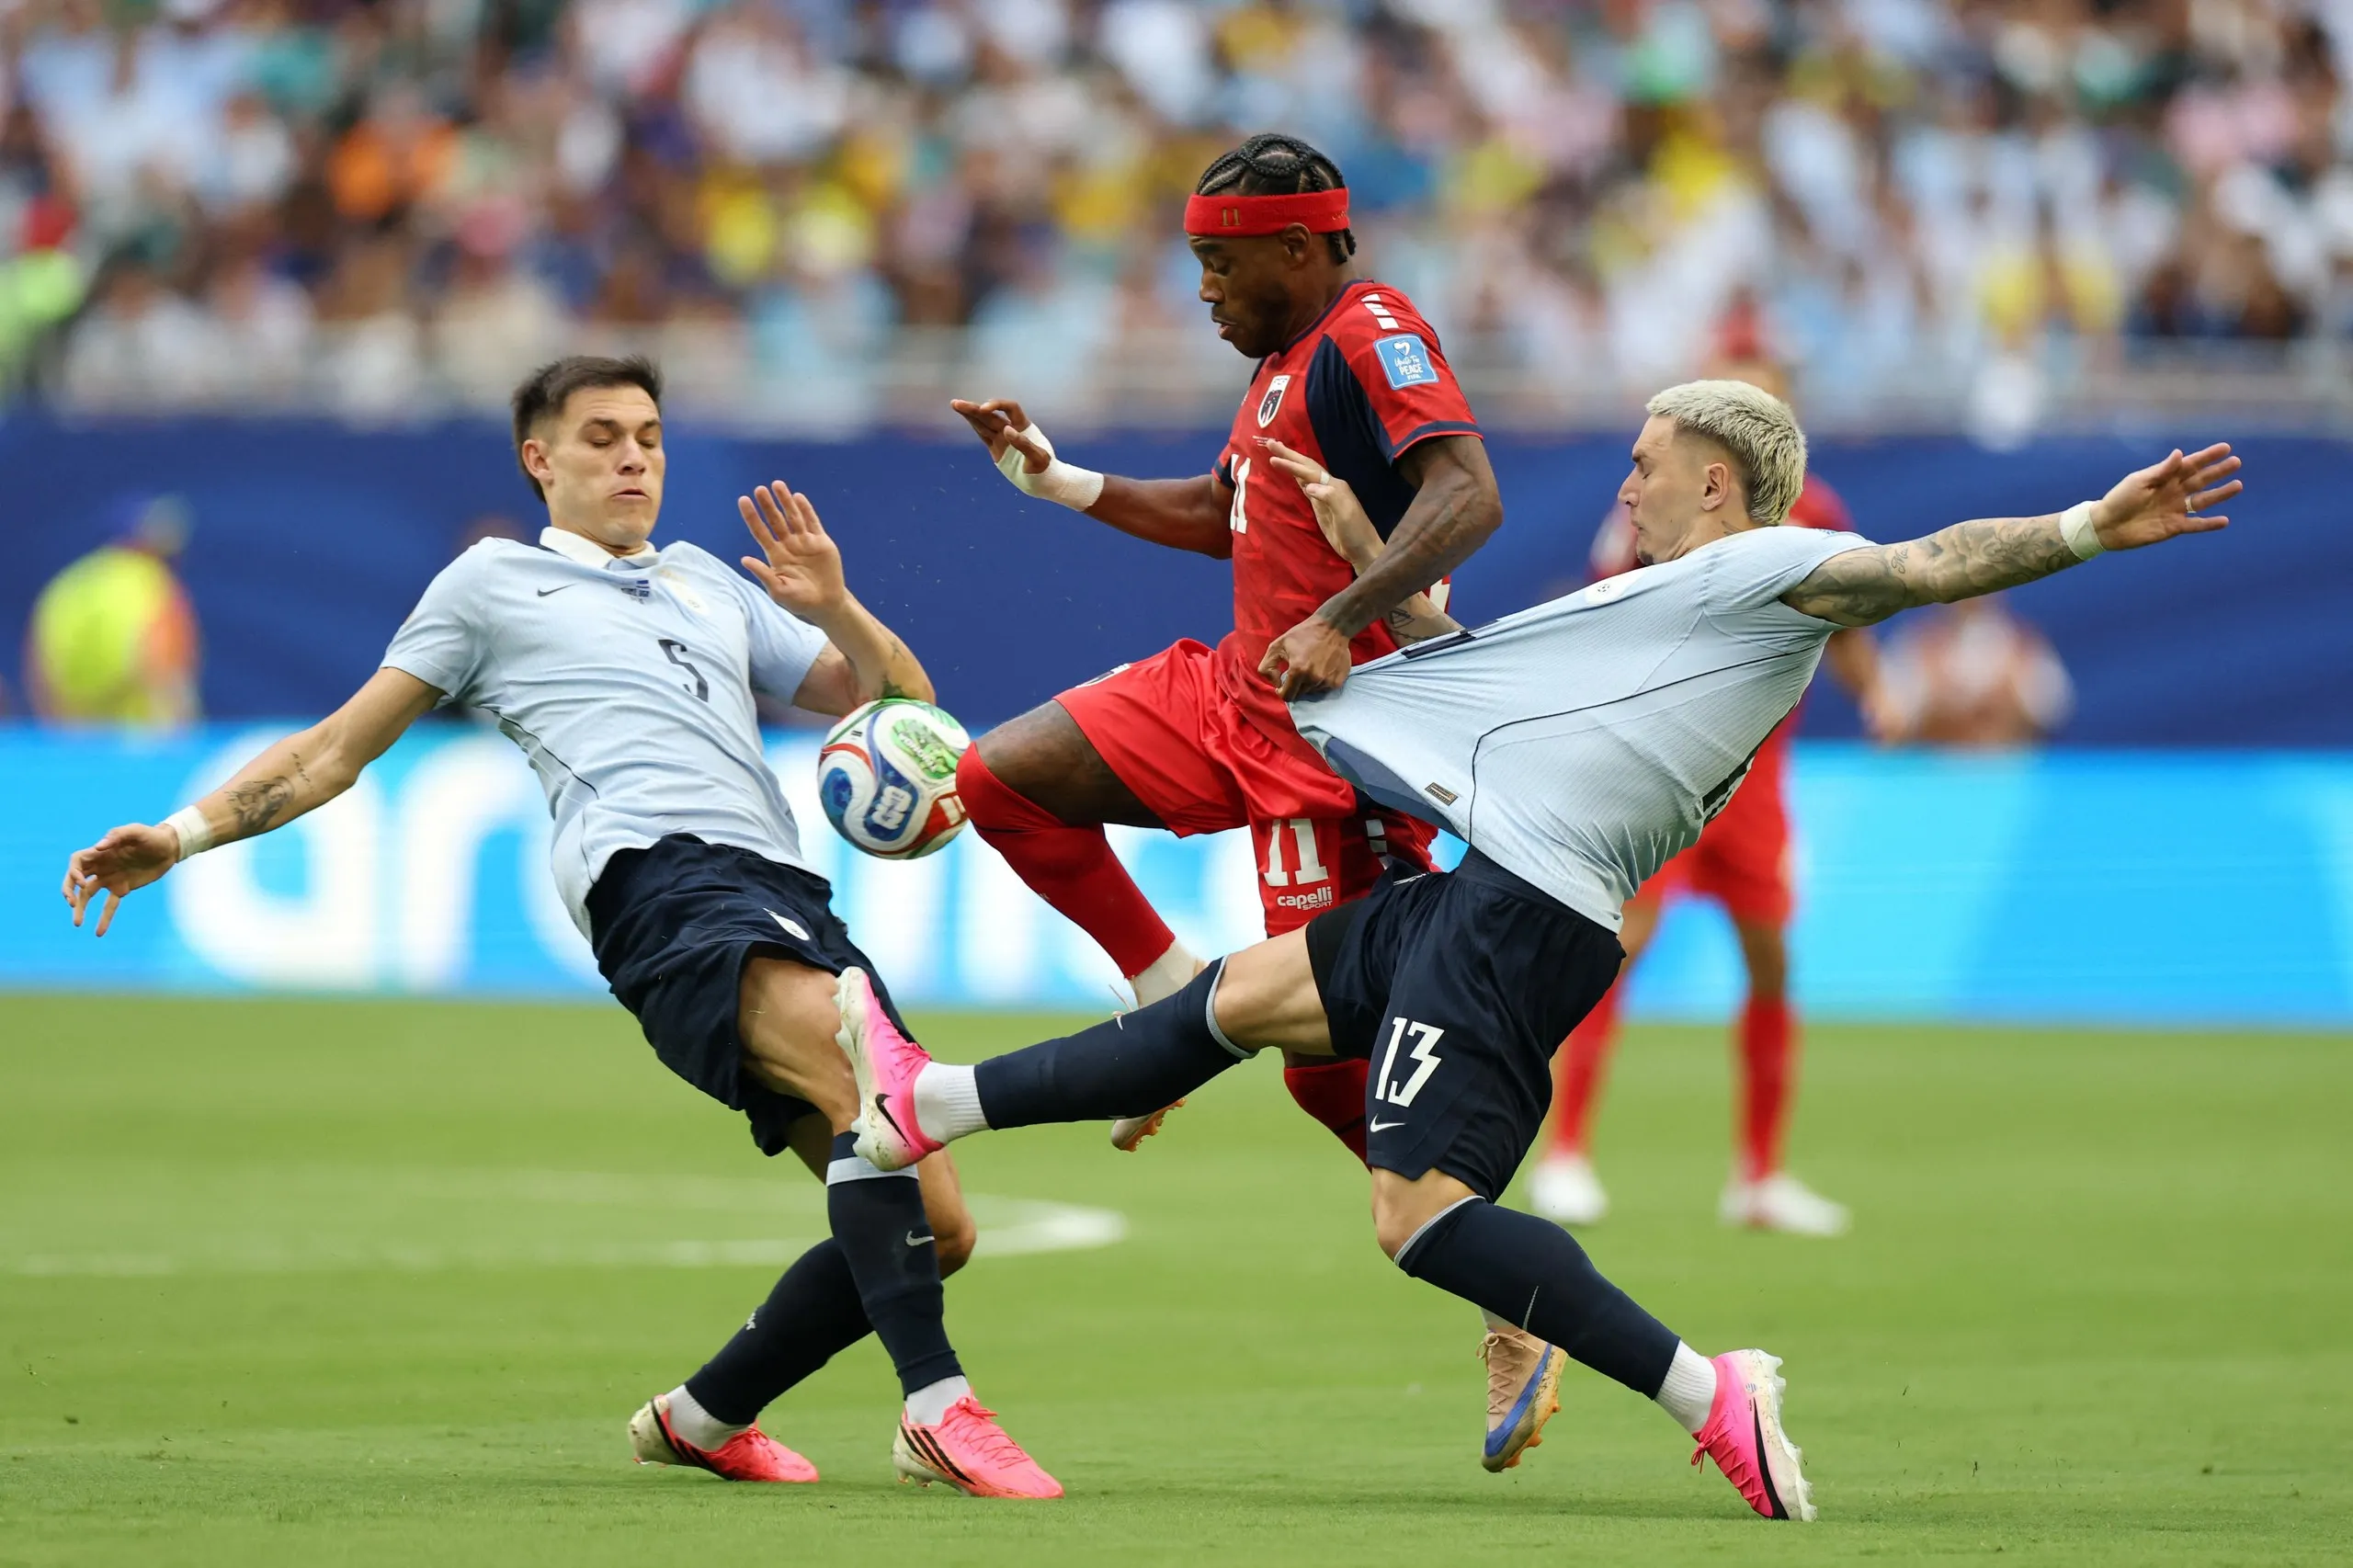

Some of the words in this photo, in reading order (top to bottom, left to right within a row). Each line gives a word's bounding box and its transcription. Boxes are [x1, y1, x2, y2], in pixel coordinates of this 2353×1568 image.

[1222, 208, 1241, 226] 11
[1399, 364, 1423, 376] PEACE
[657, 639, 710, 703] 5
[1264, 818, 1329, 887] 11
[1277, 886, 1333, 910] capelli
[1302, 900, 1334, 911] SPORT
[1375, 1017, 1445, 1108] 13
